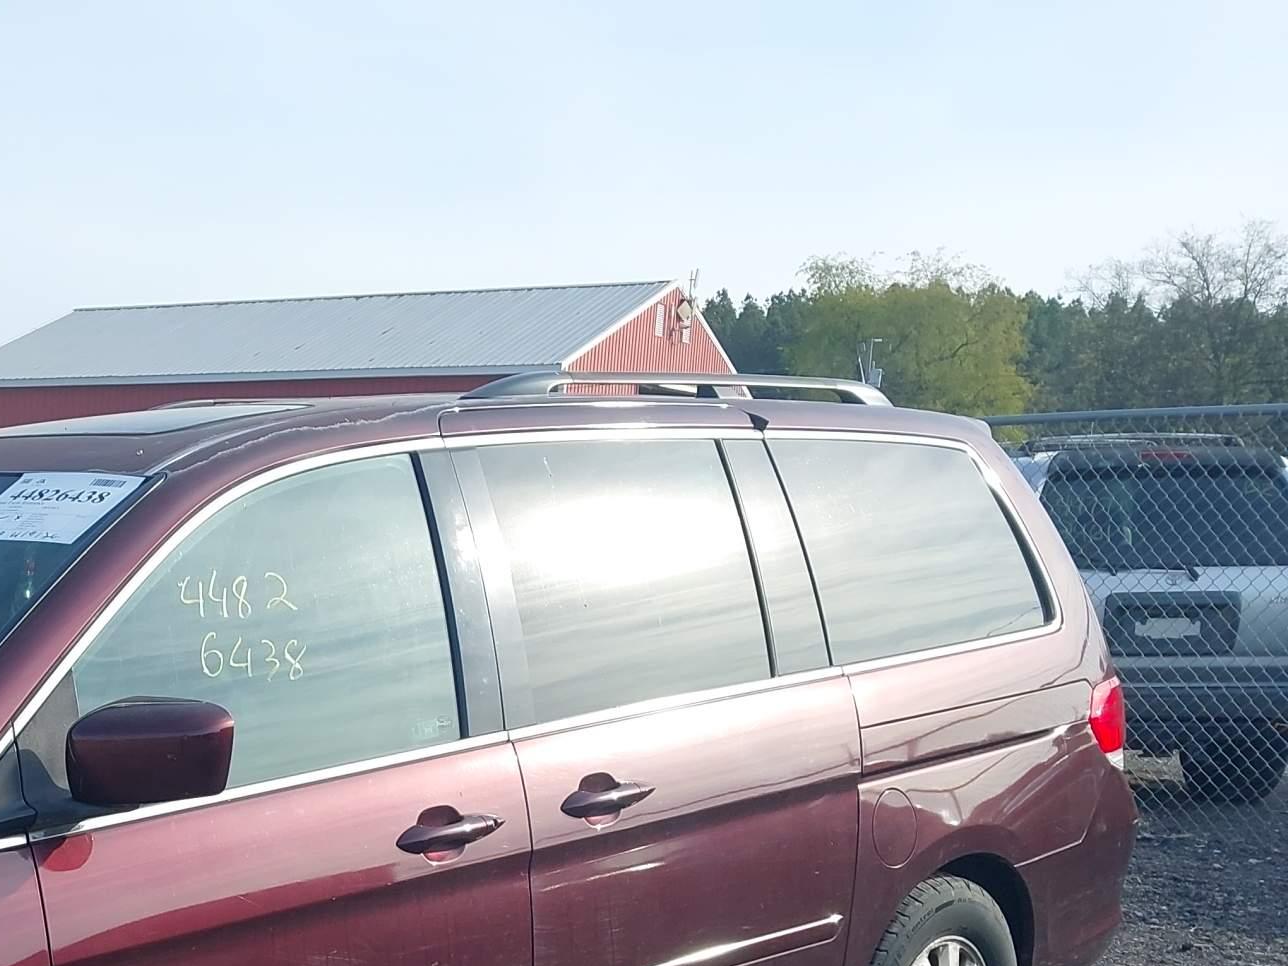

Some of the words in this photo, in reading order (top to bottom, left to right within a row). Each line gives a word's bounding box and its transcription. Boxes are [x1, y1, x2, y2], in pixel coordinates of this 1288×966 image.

[9, 488, 111, 504] 44826438
[178, 569, 298, 618] 4482
[201, 612, 307, 682] 6438
